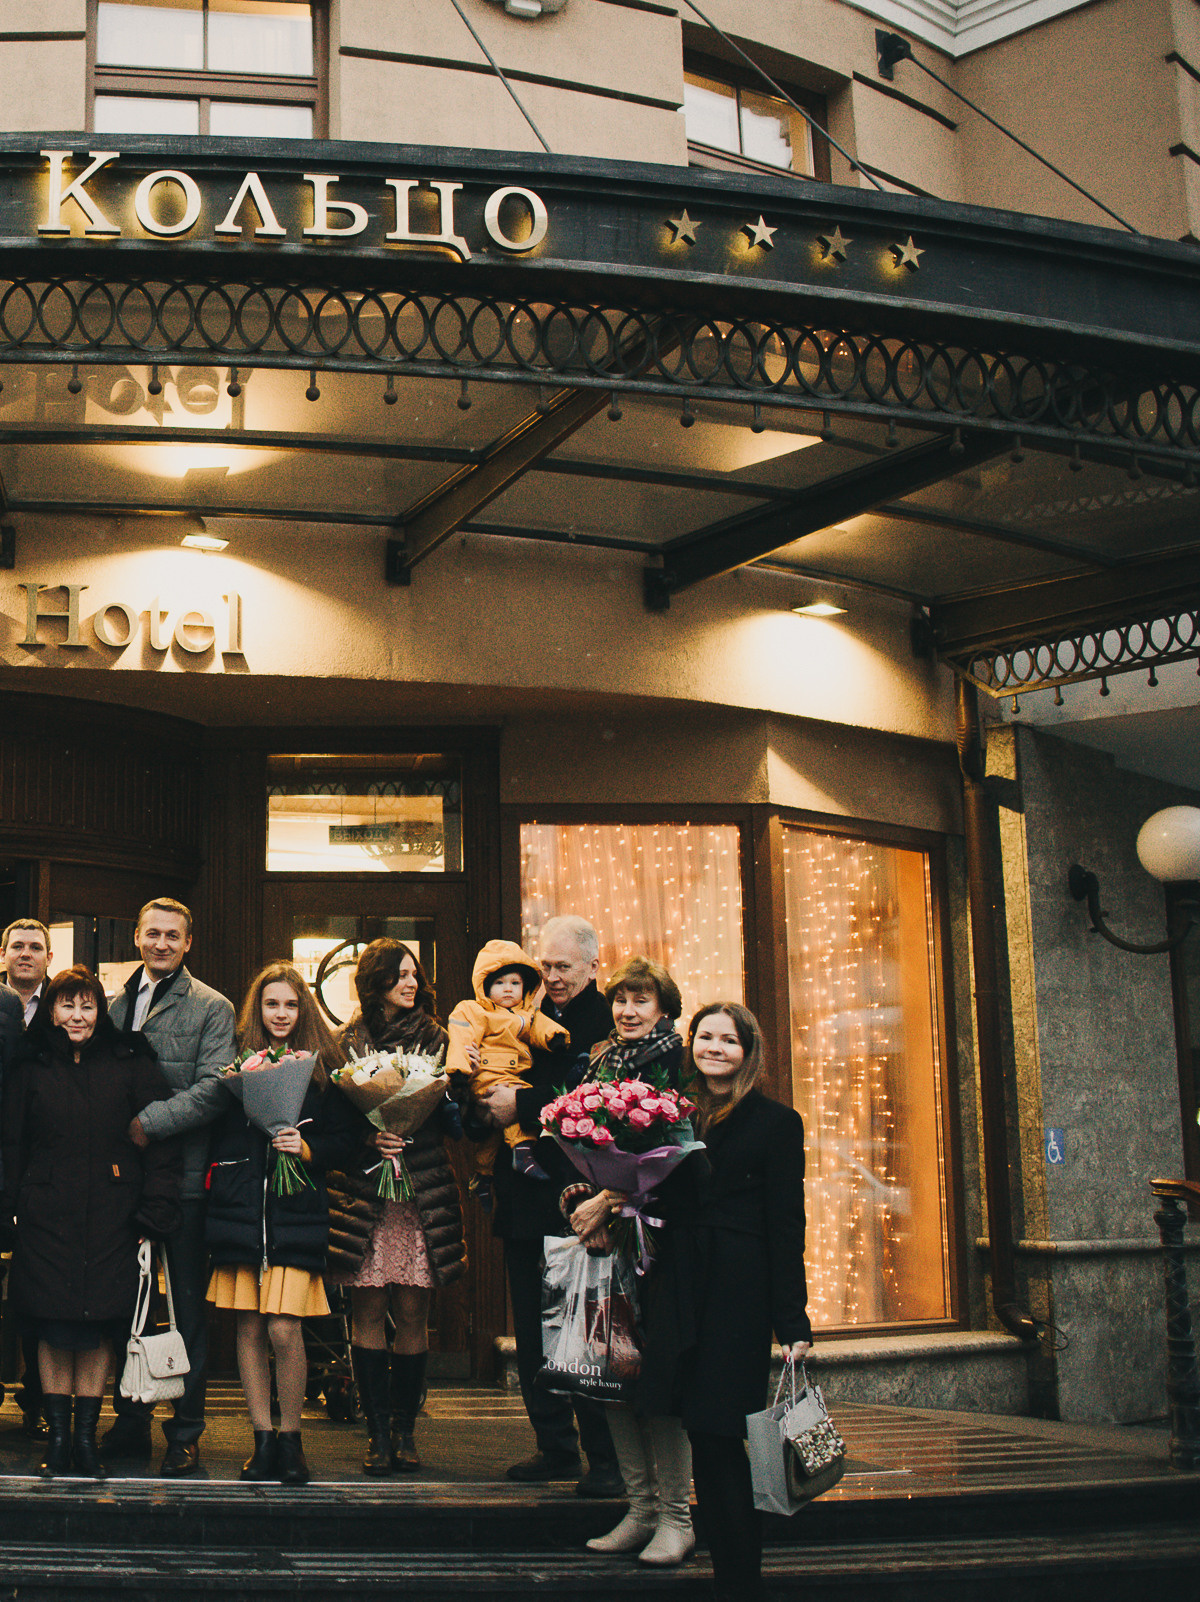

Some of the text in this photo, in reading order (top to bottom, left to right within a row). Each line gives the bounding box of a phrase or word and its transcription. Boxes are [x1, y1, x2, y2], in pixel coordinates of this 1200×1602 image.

[37, 150, 550, 262] Кольцо
[16, 583, 244, 654] Hotel
[579, 1377, 598, 1387] style
